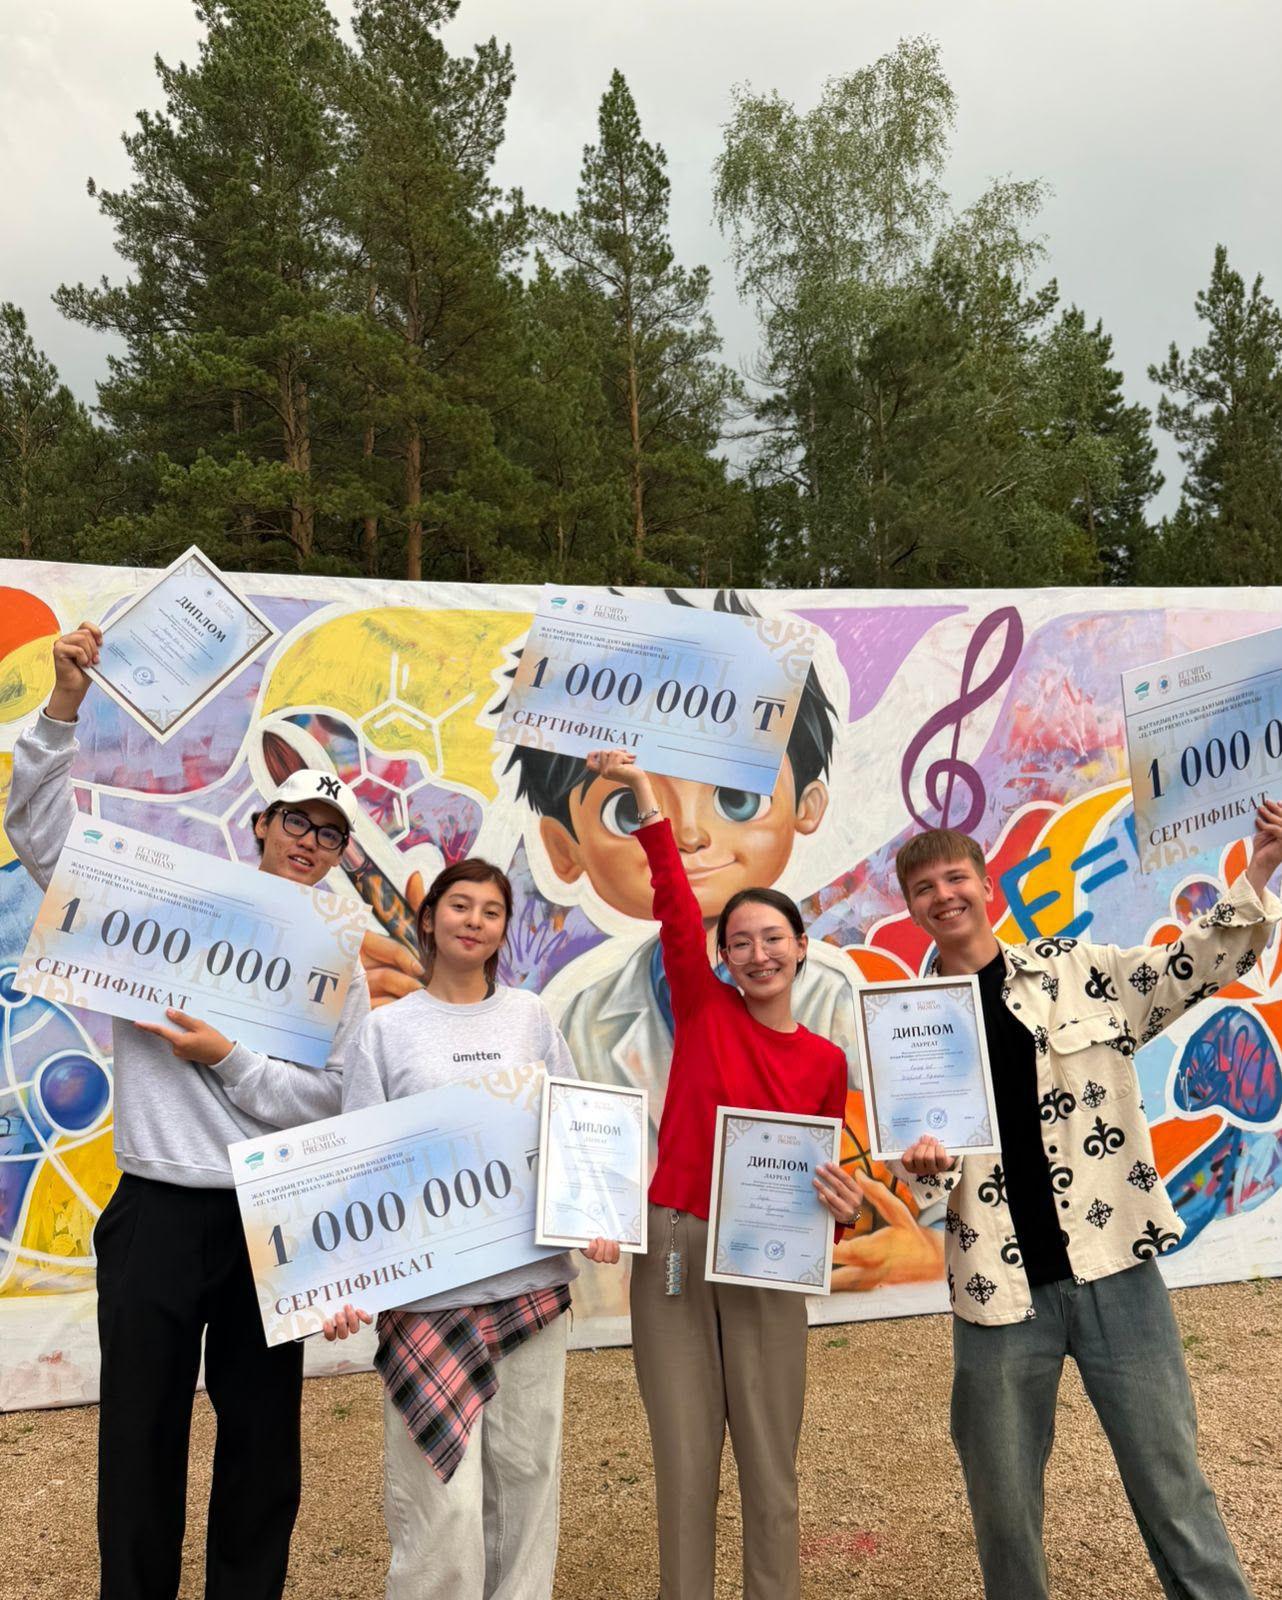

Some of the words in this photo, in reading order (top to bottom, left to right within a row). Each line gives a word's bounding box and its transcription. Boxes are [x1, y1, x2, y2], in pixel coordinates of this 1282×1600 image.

[175, 595, 227, 643] ДИПЛОМ
[529, 656, 549, 689] 1
[565, 663, 643, 706] 000
[656, 680, 737, 723] 000
[512, 710, 643, 747] СЕРТИФИКАТ
[316, 776, 341, 800] NY
[1147, 758, 1165, 800] 1
[1180, 730, 1250, 787] 000
[1150, 791, 1269, 846] СЕРТИФИКАТ
[55, 897, 81, 935] 1
[101, 909, 191, 964] 000
[206, 940, 292, 992] 000
[35, 956, 191, 1011] СЕРТИФИКАТ
[892, 1023, 954, 1040] ДИПЛОМ
[911, 1041, 939, 1049] ЛАУРЕАТ
[569, 1120, 621, 1136] ДИПЛОМ
[747, 1155, 808, 1173] ДИПЛОМ
[763, 1173, 791, 1181] ЛАУРЕАТ
[267, 1224, 293, 1268] 1
[312, 1191, 406, 1251] 000
[423, 1159, 512, 1218] 000
[275, 1251, 436, 1316] СЕРТИФИКАТ
